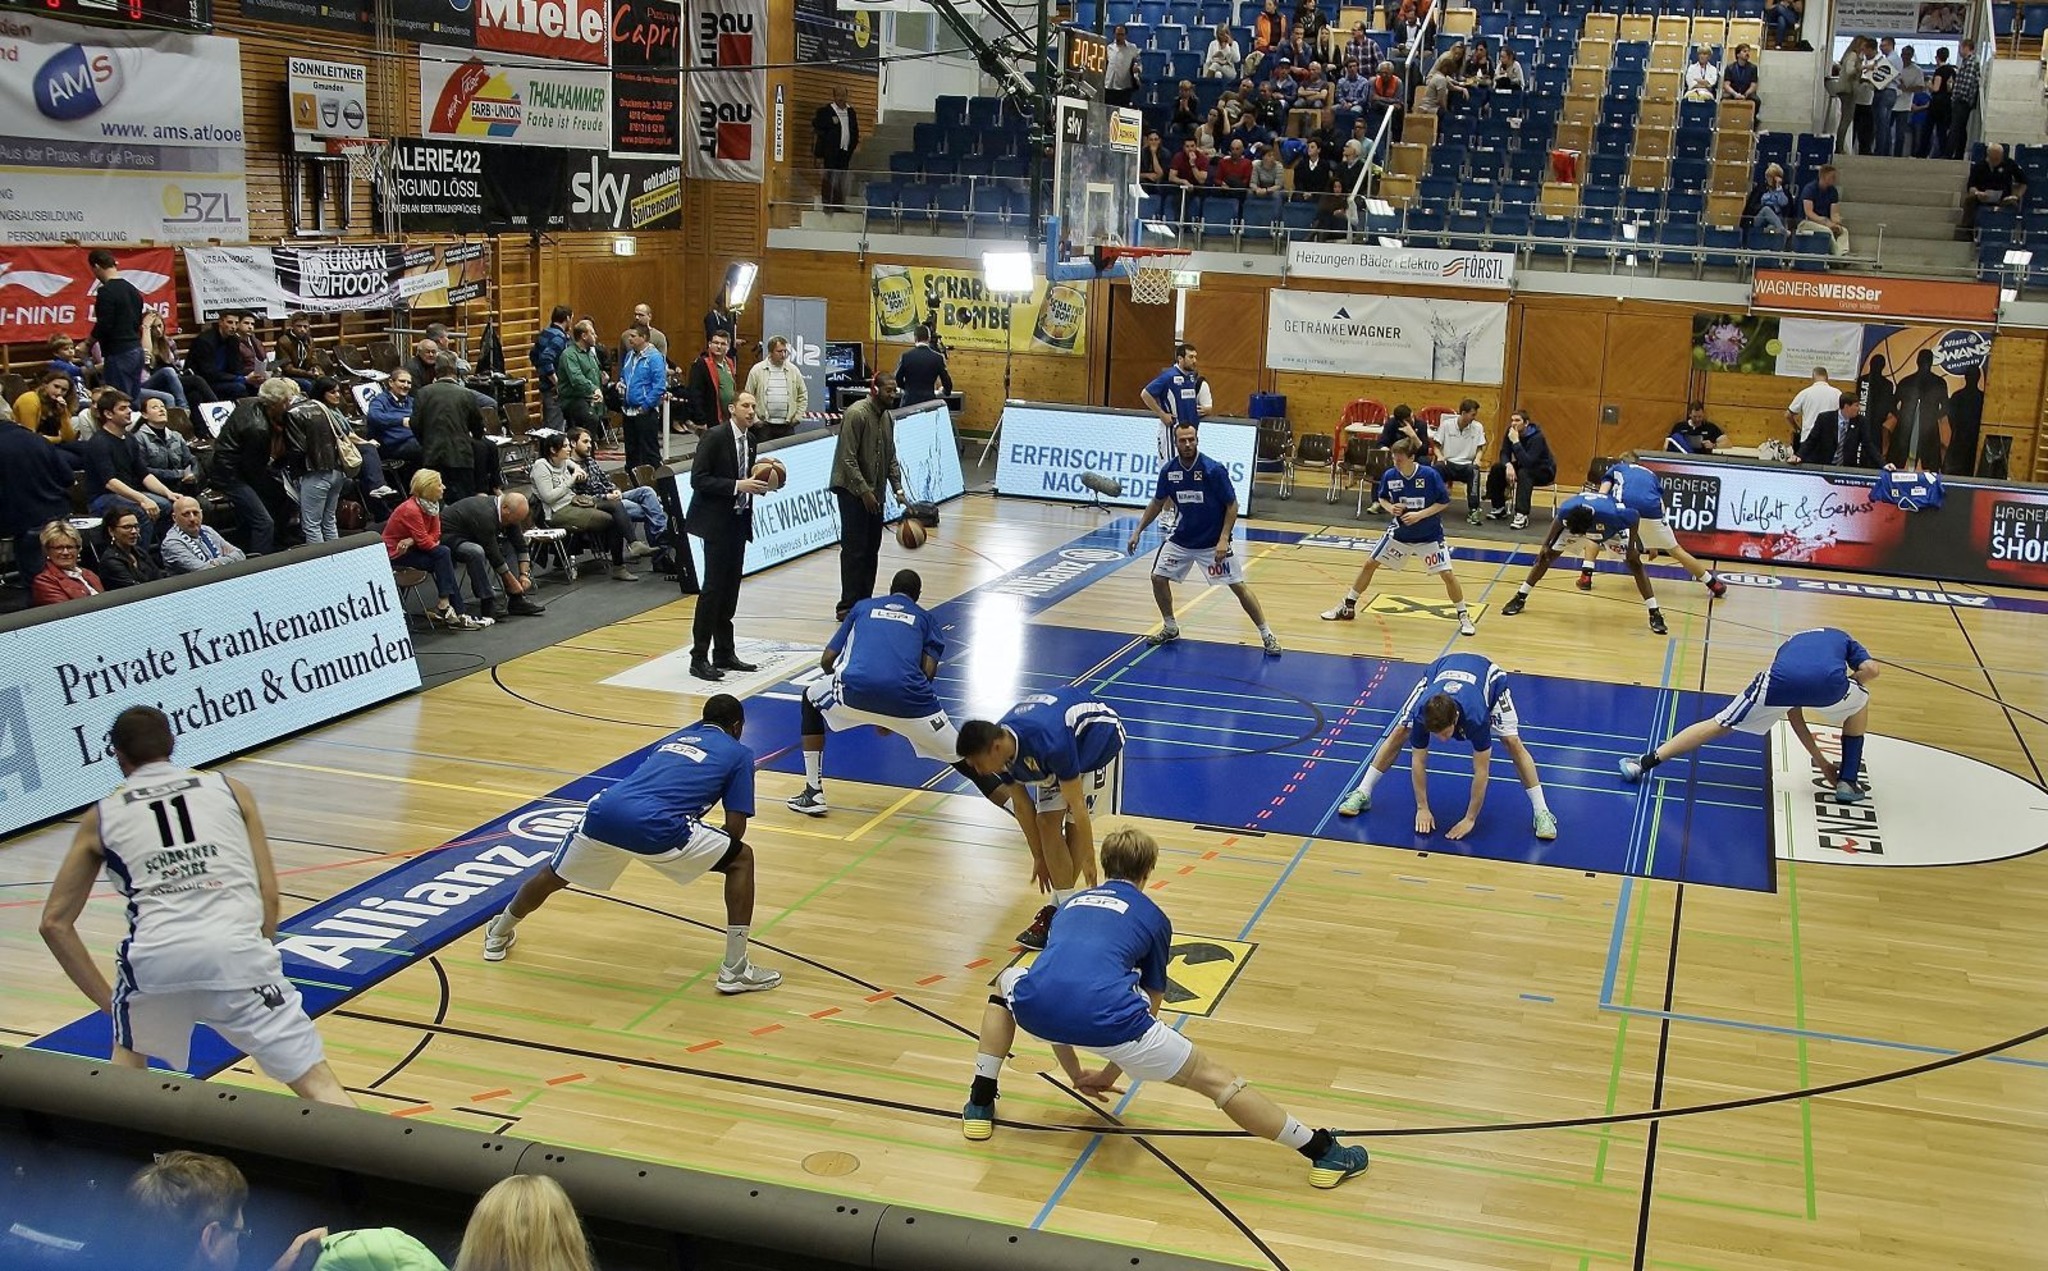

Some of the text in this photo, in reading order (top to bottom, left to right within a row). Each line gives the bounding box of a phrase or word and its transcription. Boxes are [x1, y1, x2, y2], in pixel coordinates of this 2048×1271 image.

[479, 0, 602, 44] Miele
[612, 3, 678, 60] Capri
[50, 55, 114, 107] AMS
[292, 61, 364, 80] SONNLEITNER
[313, 82, 345, 92] Gmunden
[528, 81, 605, 113] THALHAMMER
[526, 111, 554, 128] Farbe
[557, 114, 569, 129] ist
[1067, 110, 1083, 141] sky
[24, 146, 43, 162] der
[106, 148, 122, 165] die
[124, 150, 155, 166] Praxis
[391, 147, 482, 174] ALERIE422
[571, 155, 631, 228] sky
[182, 192, 242, 223] BZL
[7, 231, 127, 242] PERSONALENTWICKLUNG
[328, 248, 388, 272] URBAN
[1296, 250, 1355, 267] Heizungen
[331, 271, 389, 296] HOOPS
[944, 302, 1011, 331] BOMBE
[1931, 340, 1992, 366] SWANS
[1010, 443, 1127, 472] ERFRISCHT
[1042, 471, 1092, 493] NAC
[1665, 507, 1714, 532] HOP
[1730, 488, 1787, 531] Vielfalt
[1818, 492, 1874, 520] Genuss
[1797, 579, 1991, 606] Allianz
[54, 581, 392, 707] Private Krankenanstalt
[72, 634, 415, 768] Lairchen & Gmunden
[149, 795, 197, 848] 11
[275, 845, 554, 970] Allianz
